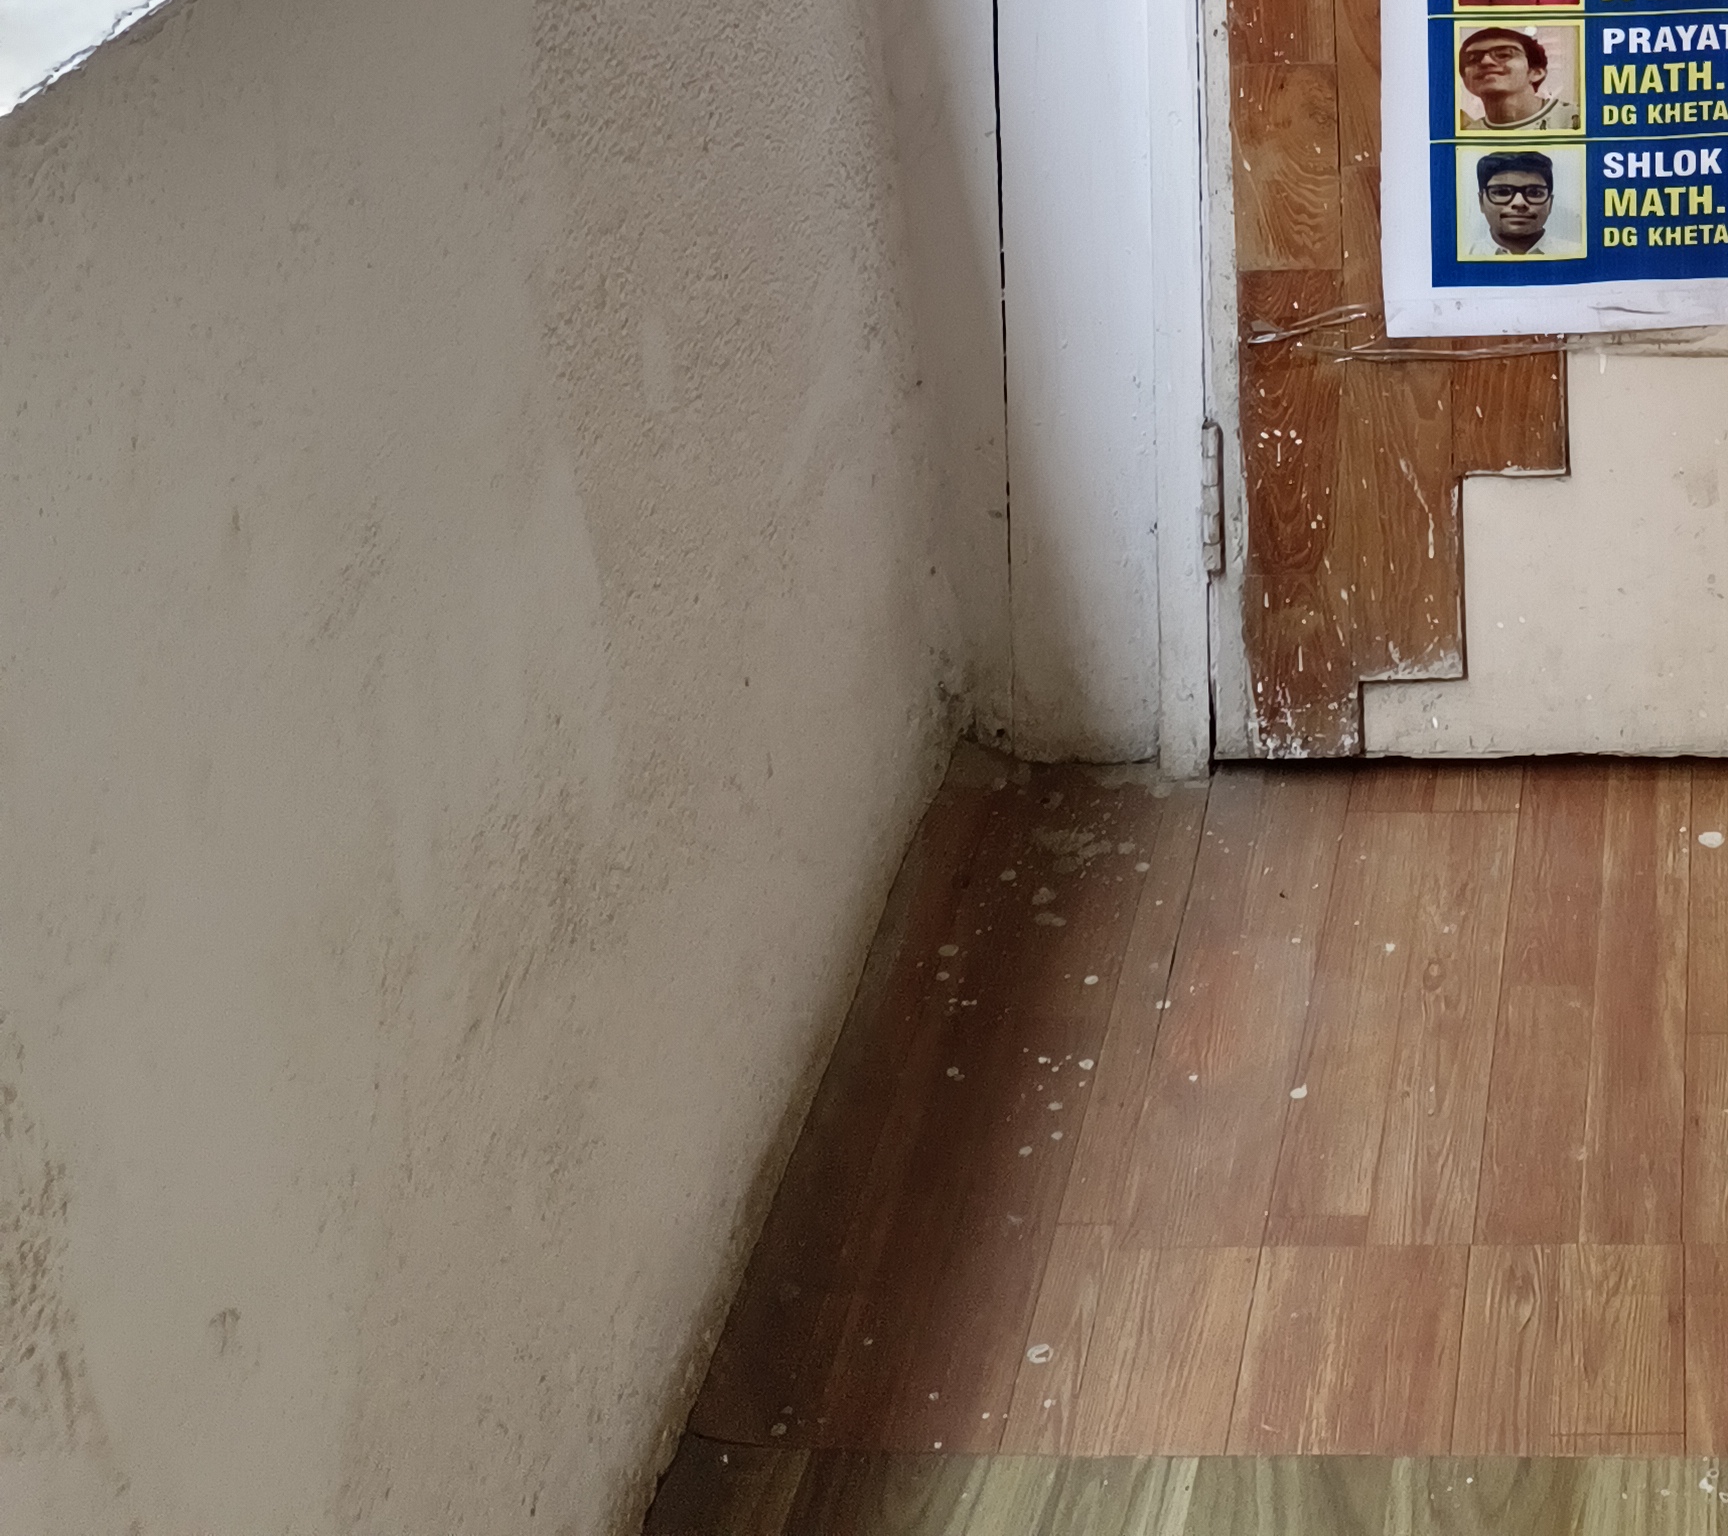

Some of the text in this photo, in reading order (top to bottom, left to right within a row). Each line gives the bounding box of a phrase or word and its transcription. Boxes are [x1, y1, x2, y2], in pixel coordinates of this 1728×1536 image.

[1603, 60, 1726, 95] MATH.
[1602, 104, 1637, 126] DG
[1602, 147, 1723, 179] SHLOK
[1604, 184, 1726, 217] MATH.
[1603, 226, 1638, 247] DG
